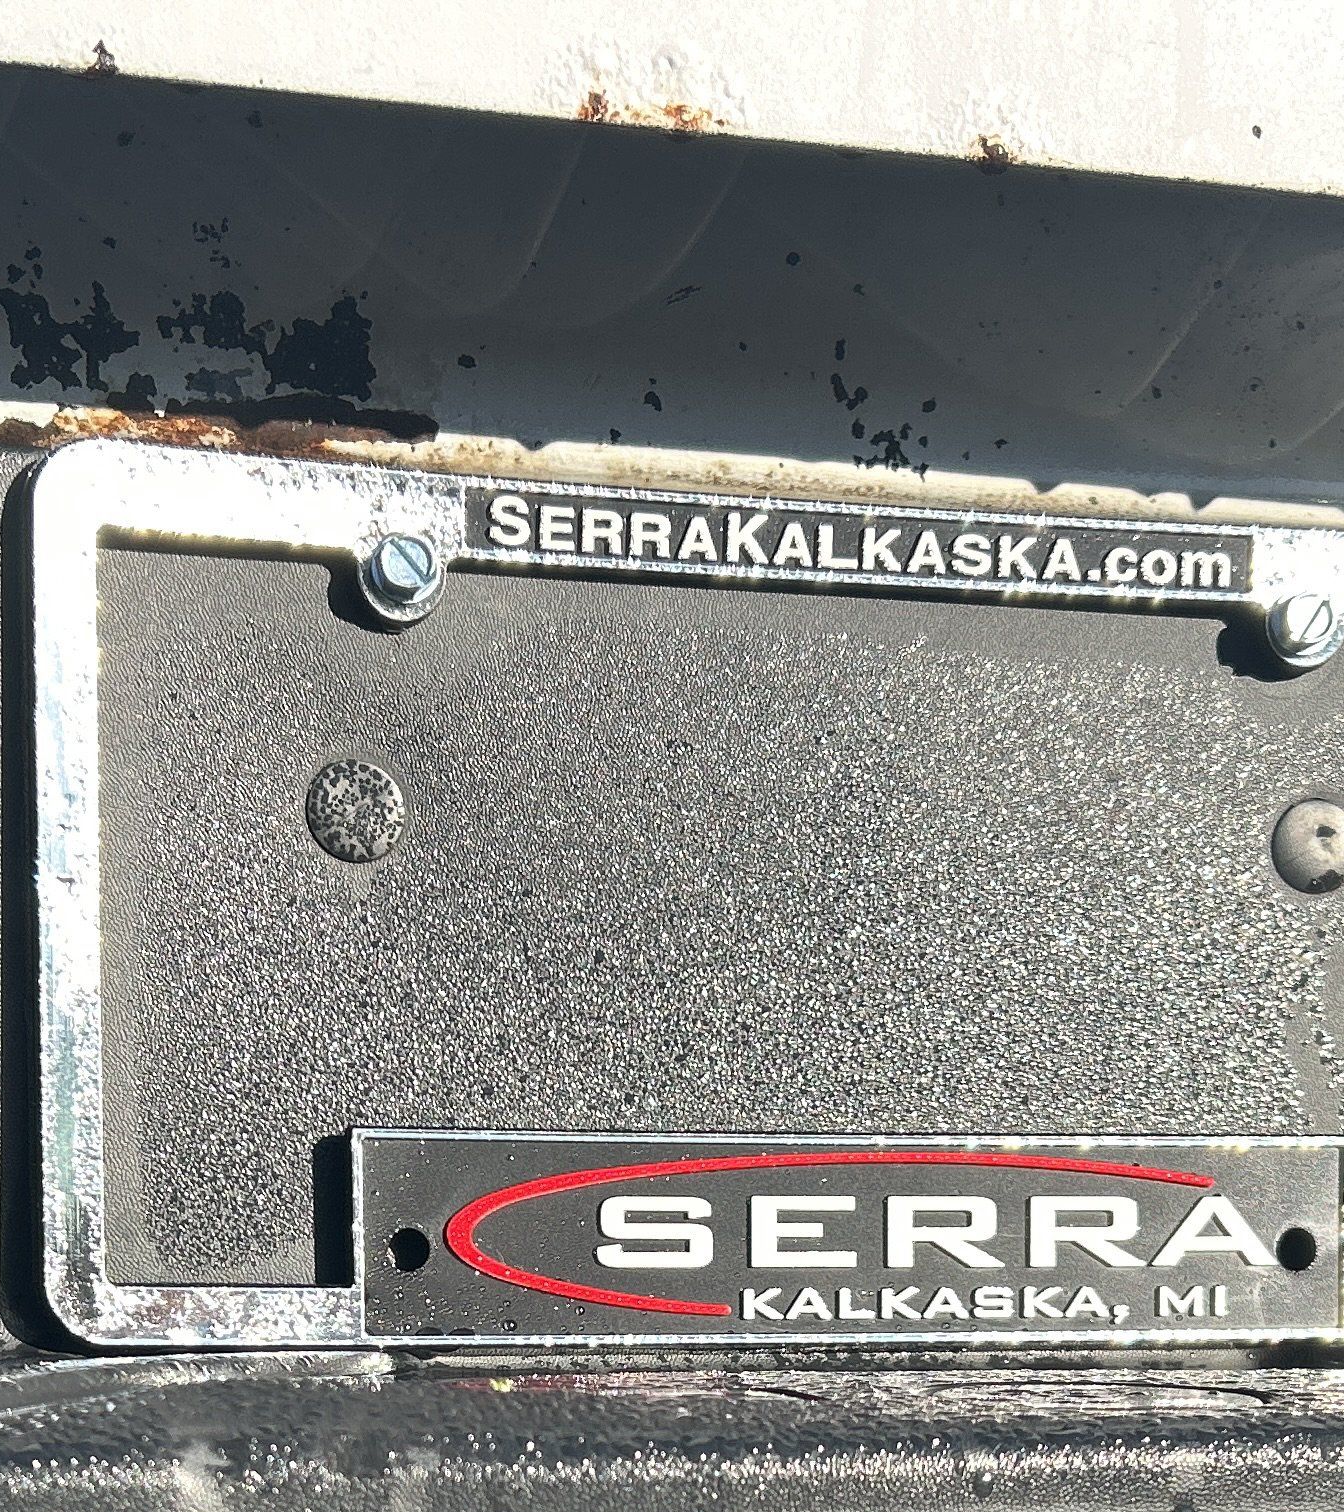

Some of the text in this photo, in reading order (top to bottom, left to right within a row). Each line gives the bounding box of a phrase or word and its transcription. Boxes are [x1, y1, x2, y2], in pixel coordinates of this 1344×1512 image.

[488, 494, 1232, 588] SERRAKALKASKA.com
[595, 1194, 1278, 1269] SERRA
[740, 1284, 1232, 1327] KALKASKA, MI
